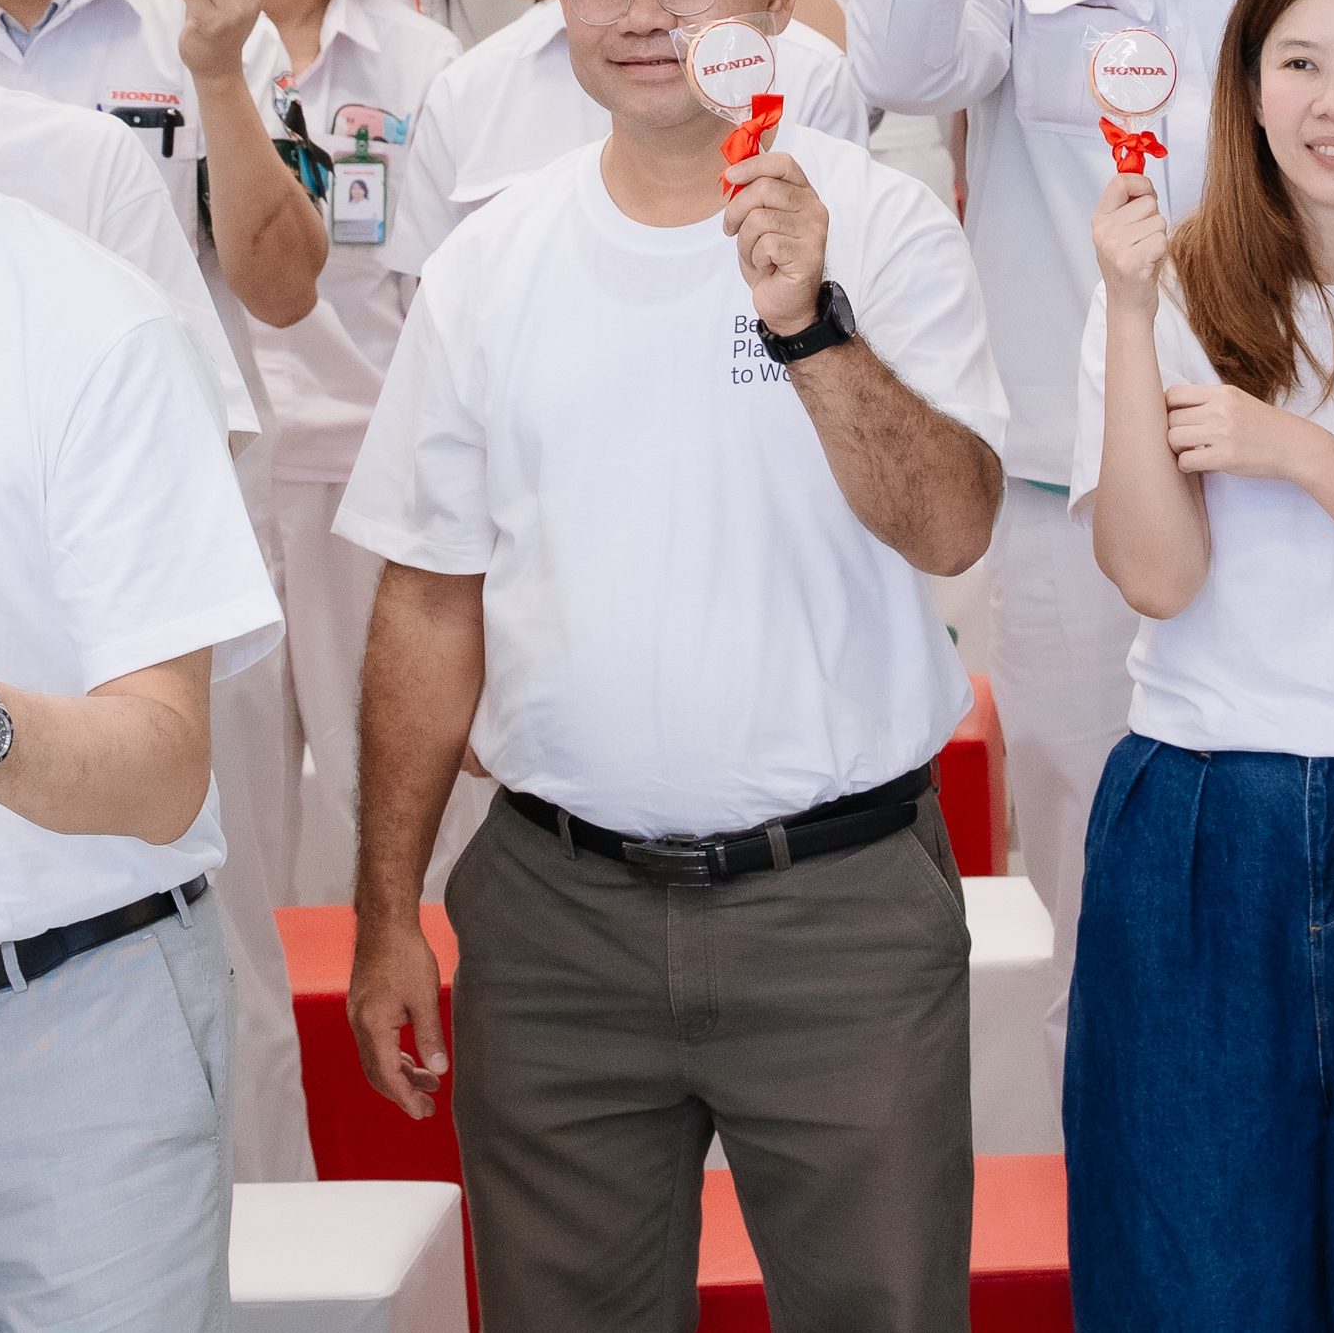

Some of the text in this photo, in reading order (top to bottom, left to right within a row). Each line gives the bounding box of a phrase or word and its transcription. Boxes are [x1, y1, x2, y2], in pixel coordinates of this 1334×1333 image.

[701, 55, 767, 77] HONDA
[1101, 66, 1168, 78] HONDA
[112, 90, 181, 105] HONDA
[734, 315, 760, 334] Be
[733, 338, 767, 359] Pla
[730, 363, 792, 384] to Wo
